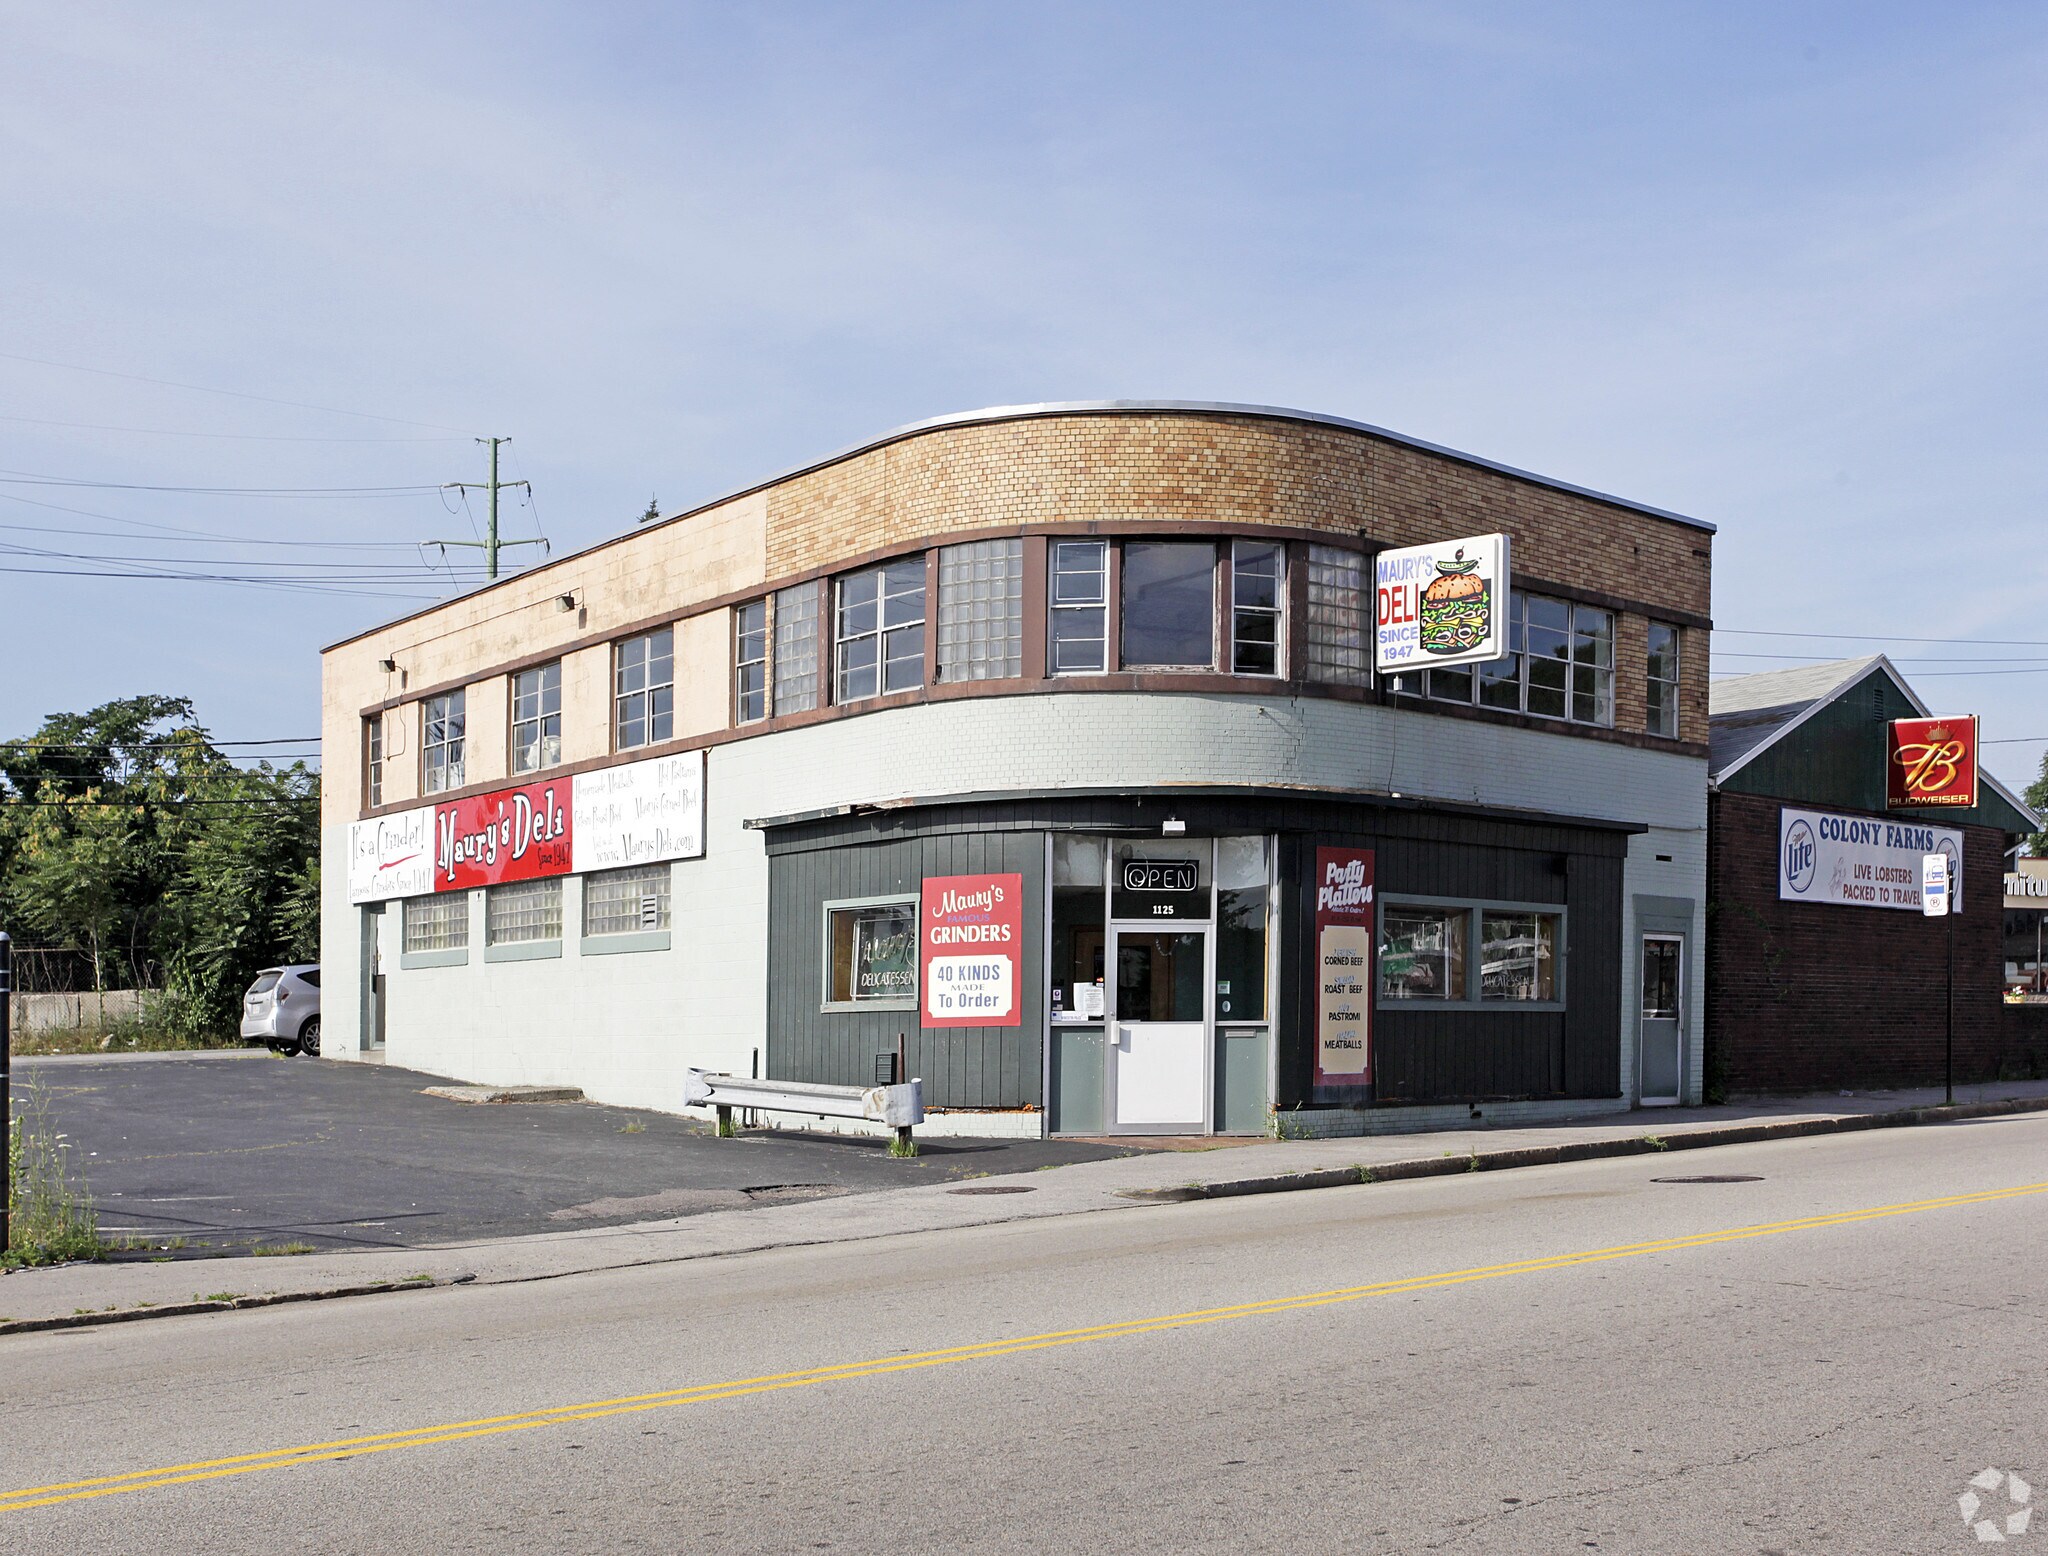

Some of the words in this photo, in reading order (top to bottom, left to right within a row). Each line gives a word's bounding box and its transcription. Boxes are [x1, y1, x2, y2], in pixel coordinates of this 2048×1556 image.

[1378, 555, 1433, 583] MAURY'S
[1378, 583, 1419, 626] DELI
[1379, 626, 1419, 644] SINCE
[1383, 645, 1414, 660] 1947
[1889, 794, 1969, 806] BUDWEISER
[352, 825, 365, 871] It's
[368, 841, 375, 855] a
[377, 810, 424, 864] Grinder!
[437, 800, 510, 882] Maury's
[512, 787, 564, 861] Deli
[1819, 816, 1882, 847] COLONY
[1885, 825, 1934, 851] FARMS
[537, 846, 553, 870] Since
[553, 841, 571, 866] 1947
[1787, 842, 1813, 882] Lite
[1129, 868, 1191, 888] OPEN
[1326, 860, 1366, 888] Party
[1853, 863, 1872, 881] LIVE
[1875, 866, 1913, 884] LOBSTERS
[932, 884, 1005, 918] Maury's
[1317, 883, 1373, 911] Platters
[1843, 884, 1876, 901] PACKED
[1879, 887, 1890, 903] TO
[1893, 889, 1921, 905] TRAVEL
[947, 914, 991, 923] FAMOUS
[1152, 905, 1175, 915] 1125
[930, 924, 1011, 945] GRINDERS
[1324, 956, 1350, 966] CORNED
[1350, 957, 1364, 966] BEEF
[937, 966, 953, 982] 40
[958, 964, 1000, 982] KINDS
[950, 983, 986, 992] MADE
[1324, 984, 1346, 994] ROAST
[1348, 985, 1363, 994] BEEF
[938, 993, 953, 1008] To
[958, 992, 999, 1008] Order
[1328, 1012, 1361, 1021] PASTROMI
[1324, 1040, 1362, 1050] MEATBALLS
